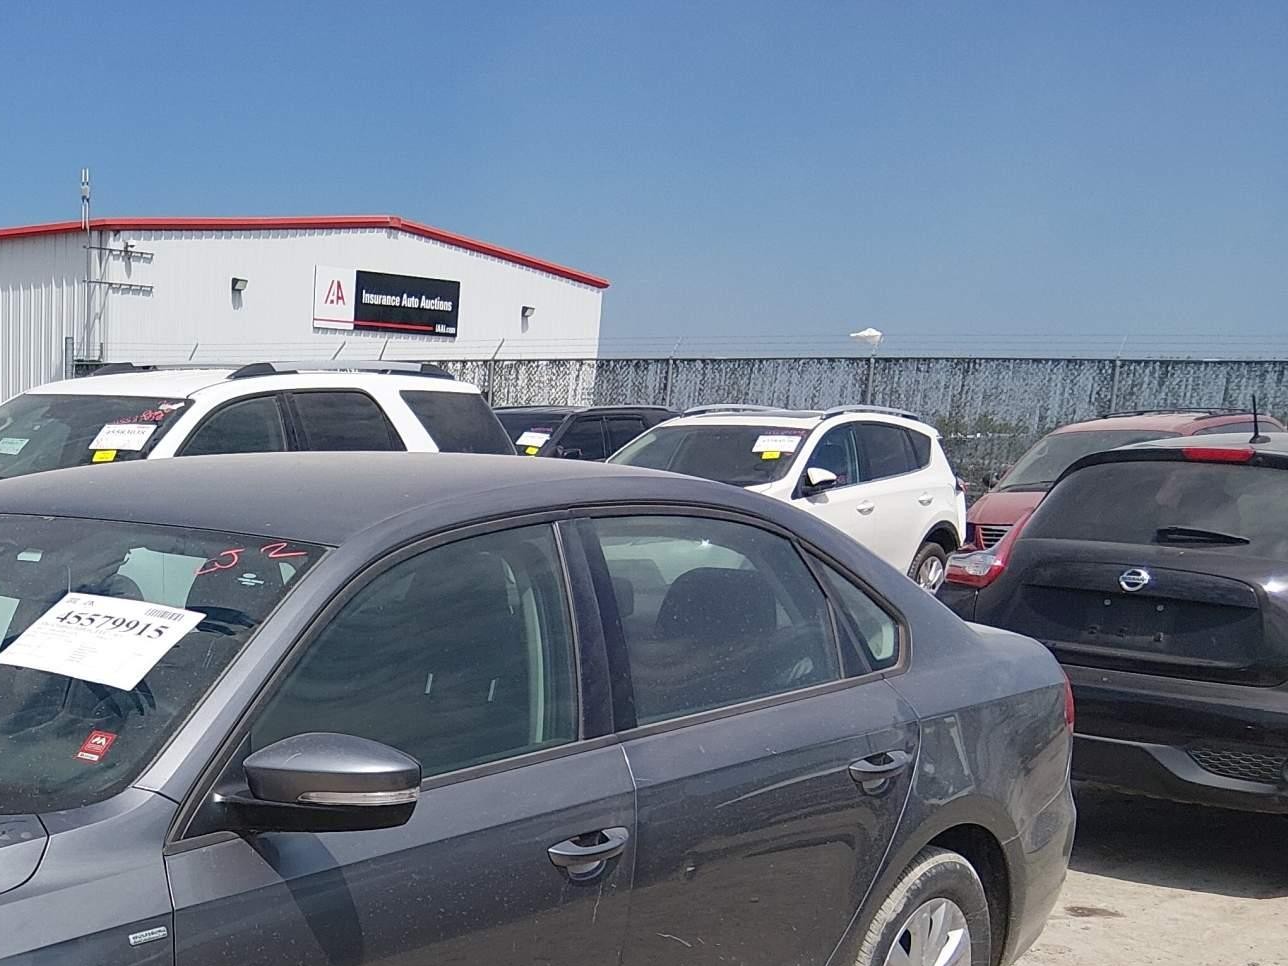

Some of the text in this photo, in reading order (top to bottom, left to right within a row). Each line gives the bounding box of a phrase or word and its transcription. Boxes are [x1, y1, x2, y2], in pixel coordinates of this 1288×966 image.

[362, 289, 453, 312] Insurance Auto Auctions
[55, 609, 170, 640] 45579915
